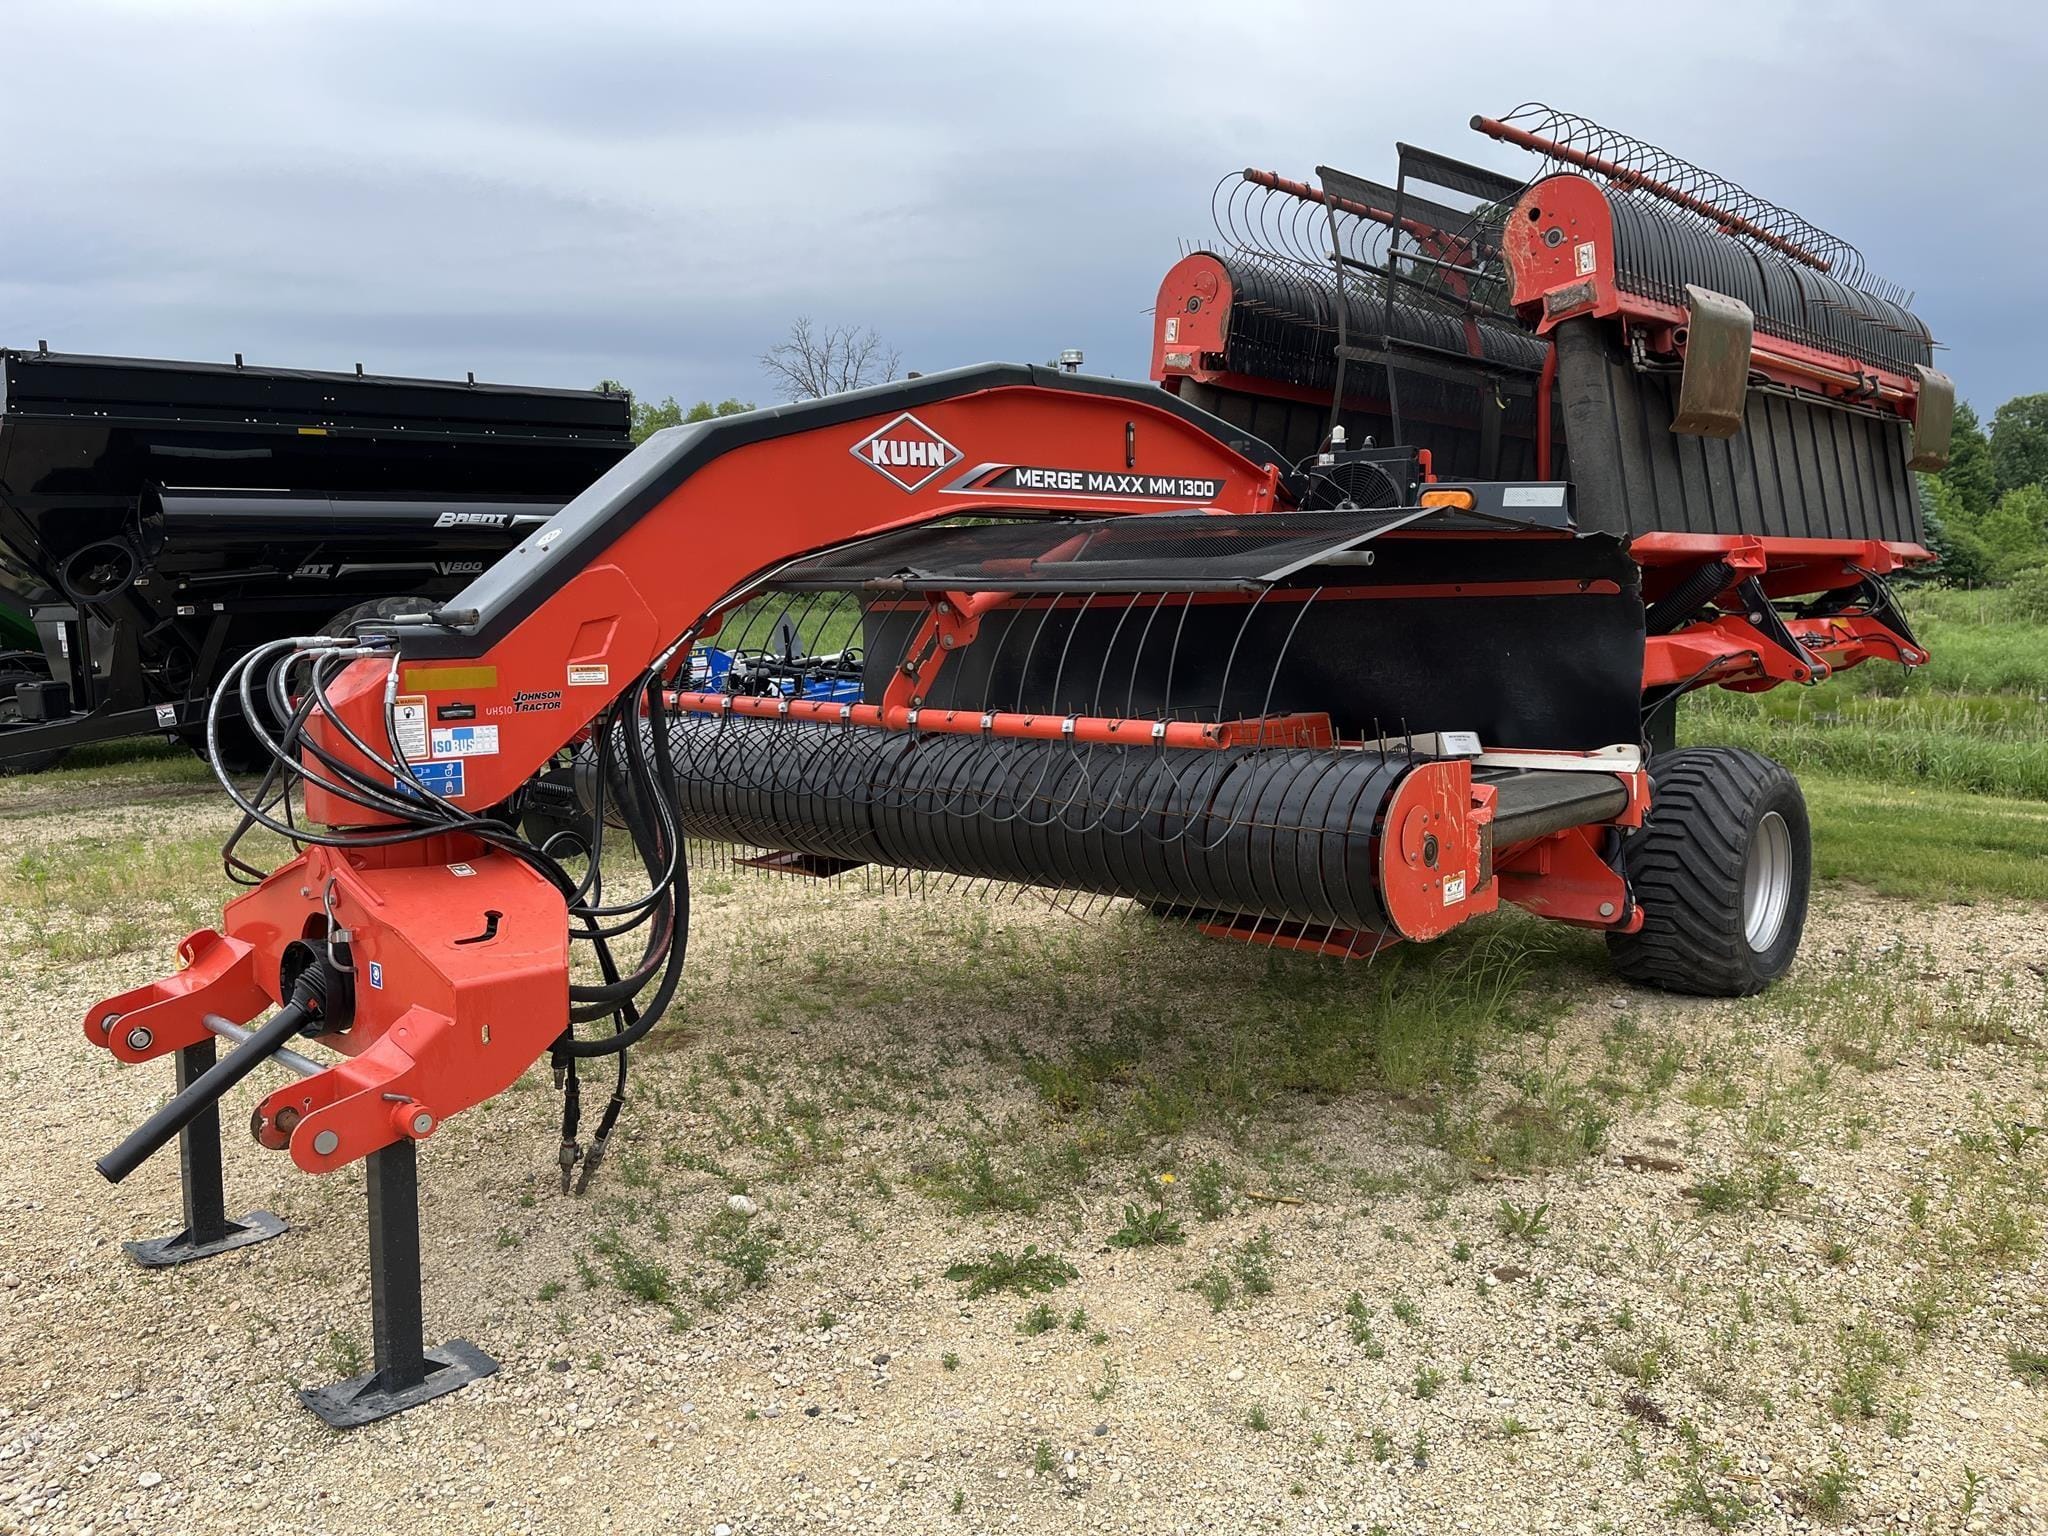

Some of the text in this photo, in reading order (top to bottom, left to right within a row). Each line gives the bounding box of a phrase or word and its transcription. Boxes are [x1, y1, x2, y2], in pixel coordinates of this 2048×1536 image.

[871, 439, 945, 467] KUHN
[1015, 468, 1215, 497] MERGE MAXX MM 1300
[439, 562, 484, 576] V800
[512, 691, 562, 702] JOHNSON
[514, 701, 562, 713] TRACTOR
[433, 738, 475, 753] ISOBUS
